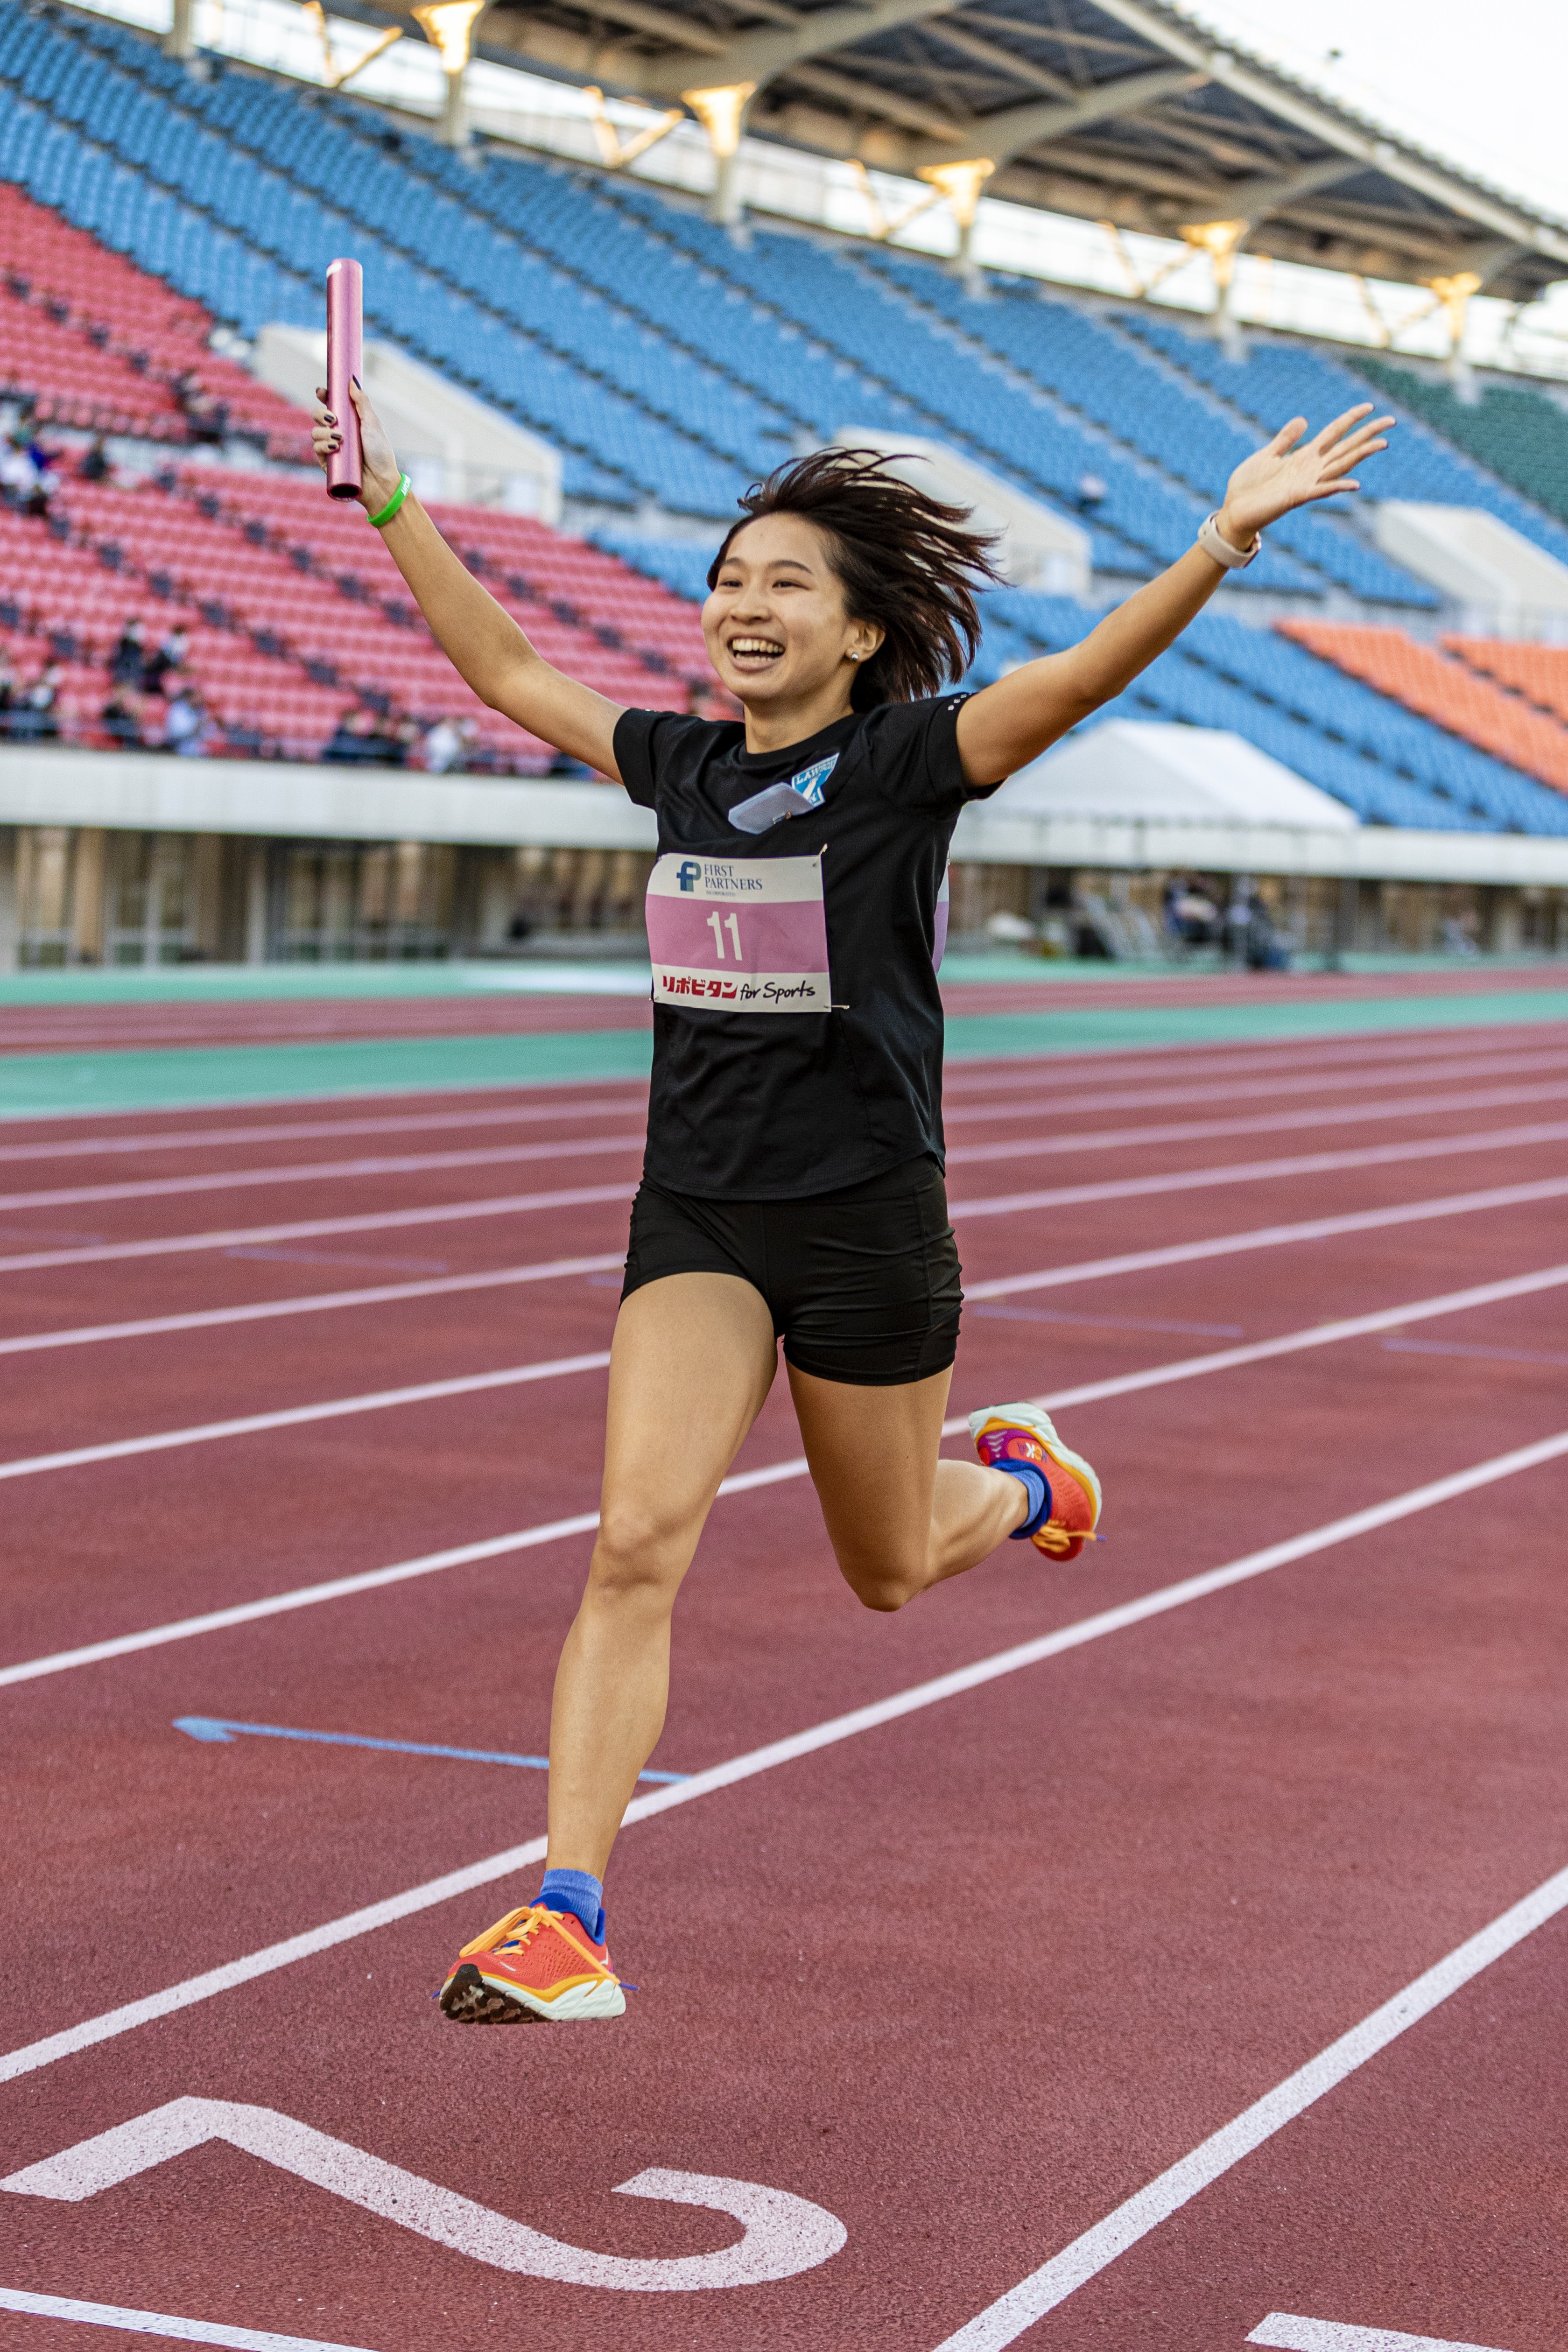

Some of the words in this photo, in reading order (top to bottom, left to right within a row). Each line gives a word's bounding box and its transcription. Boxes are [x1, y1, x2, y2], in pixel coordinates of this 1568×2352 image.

[704, 864, 734, 877] FIRST
[705, 877, 763, 890] PARTNERS
[707, 911, 743, 961] 11
[663, 976, 738, 999] リポビタン
[740, 983, 761, 1000] for
[763, 980, 816, 1004] Sports
[0, 2095, 847, 2291] 2
